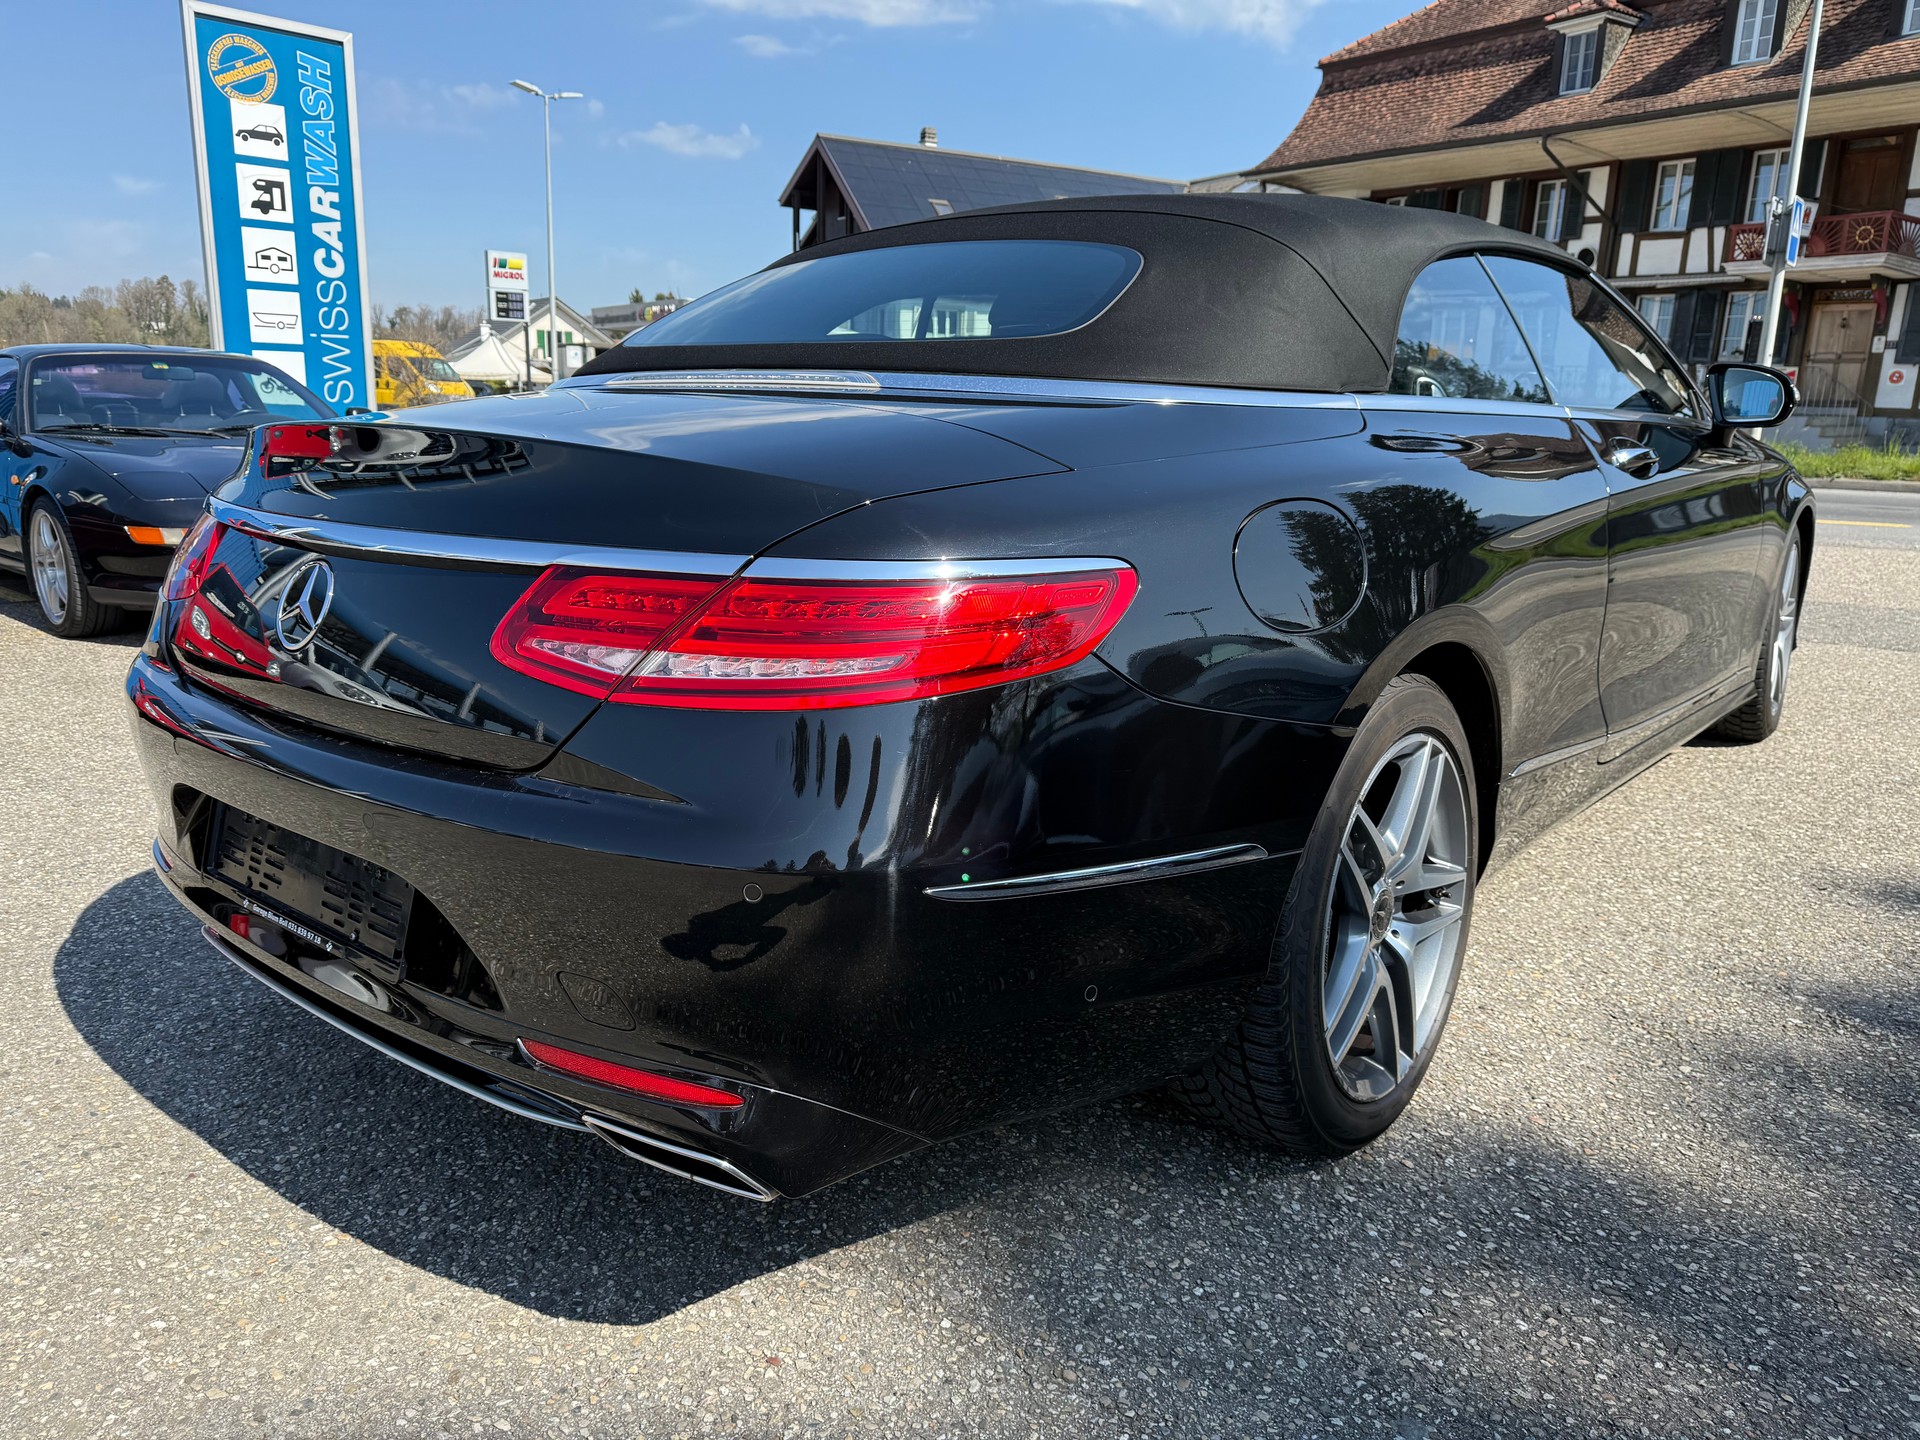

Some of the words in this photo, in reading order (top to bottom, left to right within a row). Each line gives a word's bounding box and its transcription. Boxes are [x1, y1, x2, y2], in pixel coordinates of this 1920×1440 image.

[215, 58, 274, 87] OSMOSEWASSER
[493, 270, 524, 281] MIGROL
[288, 921, 297, 932] 031
